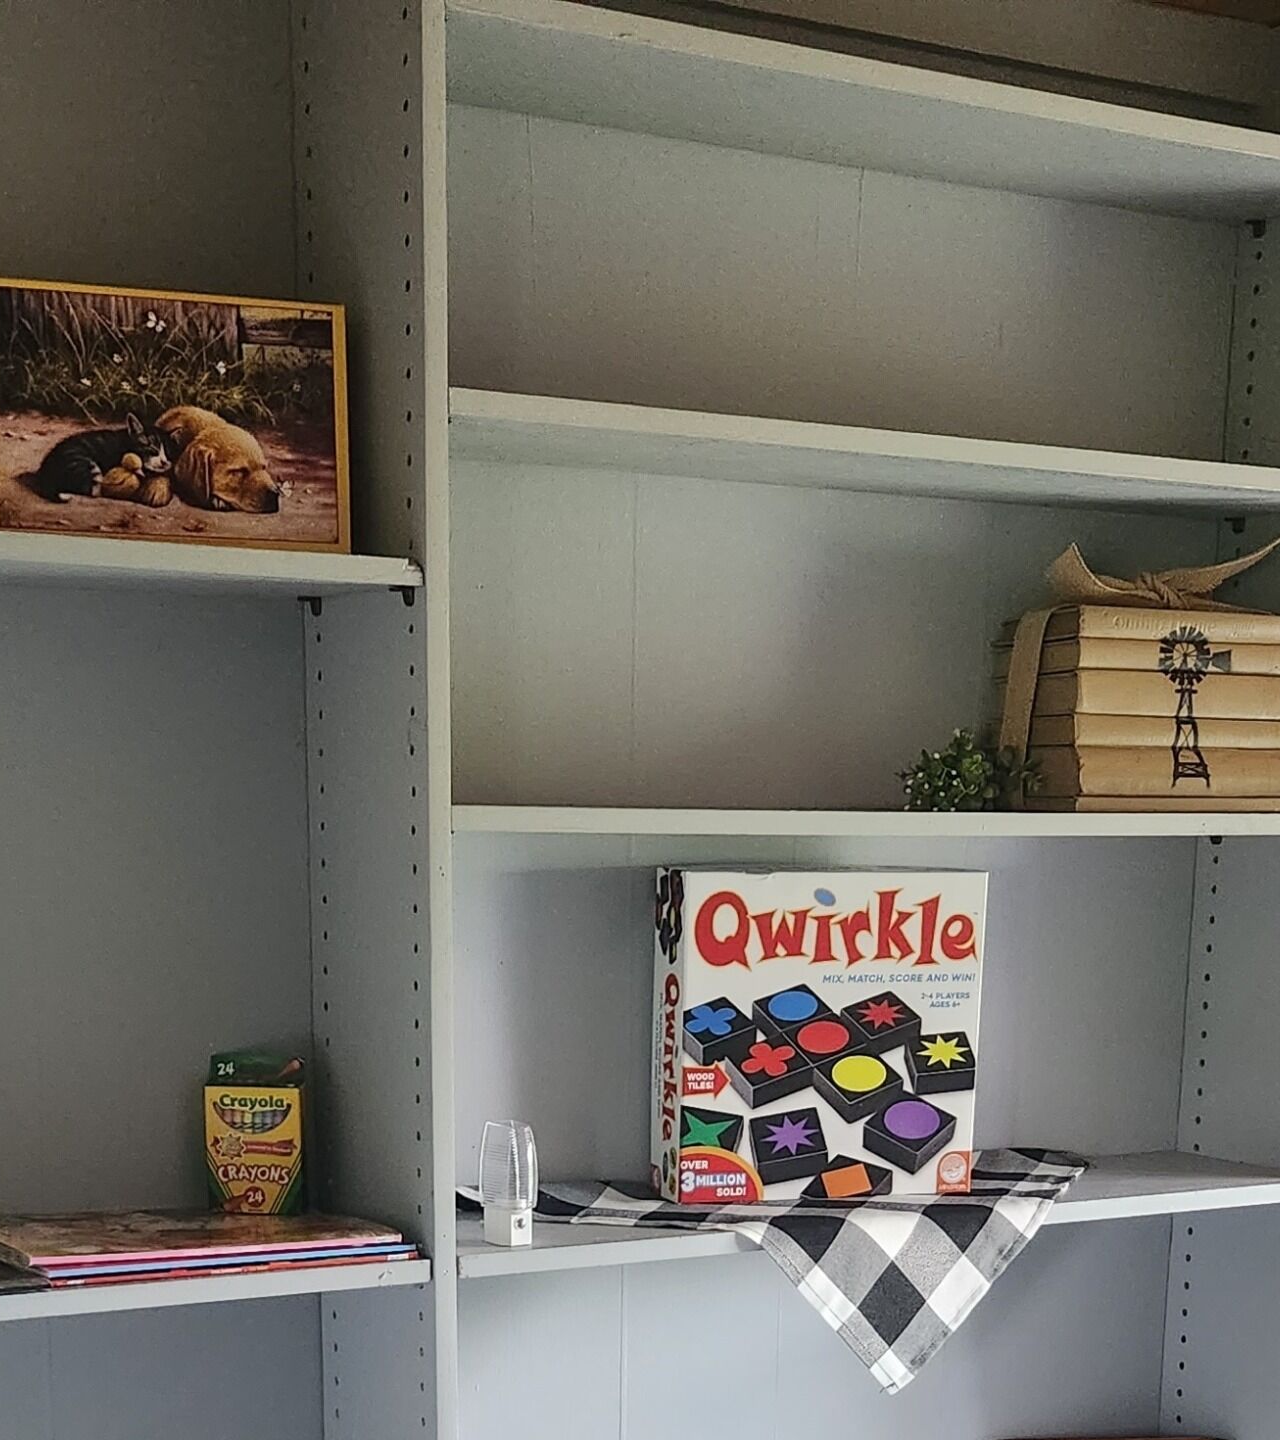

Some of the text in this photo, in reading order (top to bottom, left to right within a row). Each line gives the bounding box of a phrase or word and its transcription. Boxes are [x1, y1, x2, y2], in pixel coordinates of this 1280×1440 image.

[694, 887, 978, 971] Qwirkle
[822, 973, 975, 984] MIX, MATCH, SCORE AND WIN!
[921, 992, 970, 1000] 2-4 PLAYERS
[929, 1001, 951, 1009] AGES
[662, 972, 680, 1142] Qwirkle
[217, 1062, 235, 1075] 24
[687, 1073, 715, 1081] WOOD
[687, 1081, 714, 1090] TILES!
[219, 1094, 285, 1111] Crayola
[680, 1160, 708, 1170] OVER
[218, 1164, 290, 1185] CRAYONS
[681, 1171, 746, 1192] 3 MILLION
[247, 1191, 263, 1203] 24
[716, 1187, 746, 1197] SOLD!
